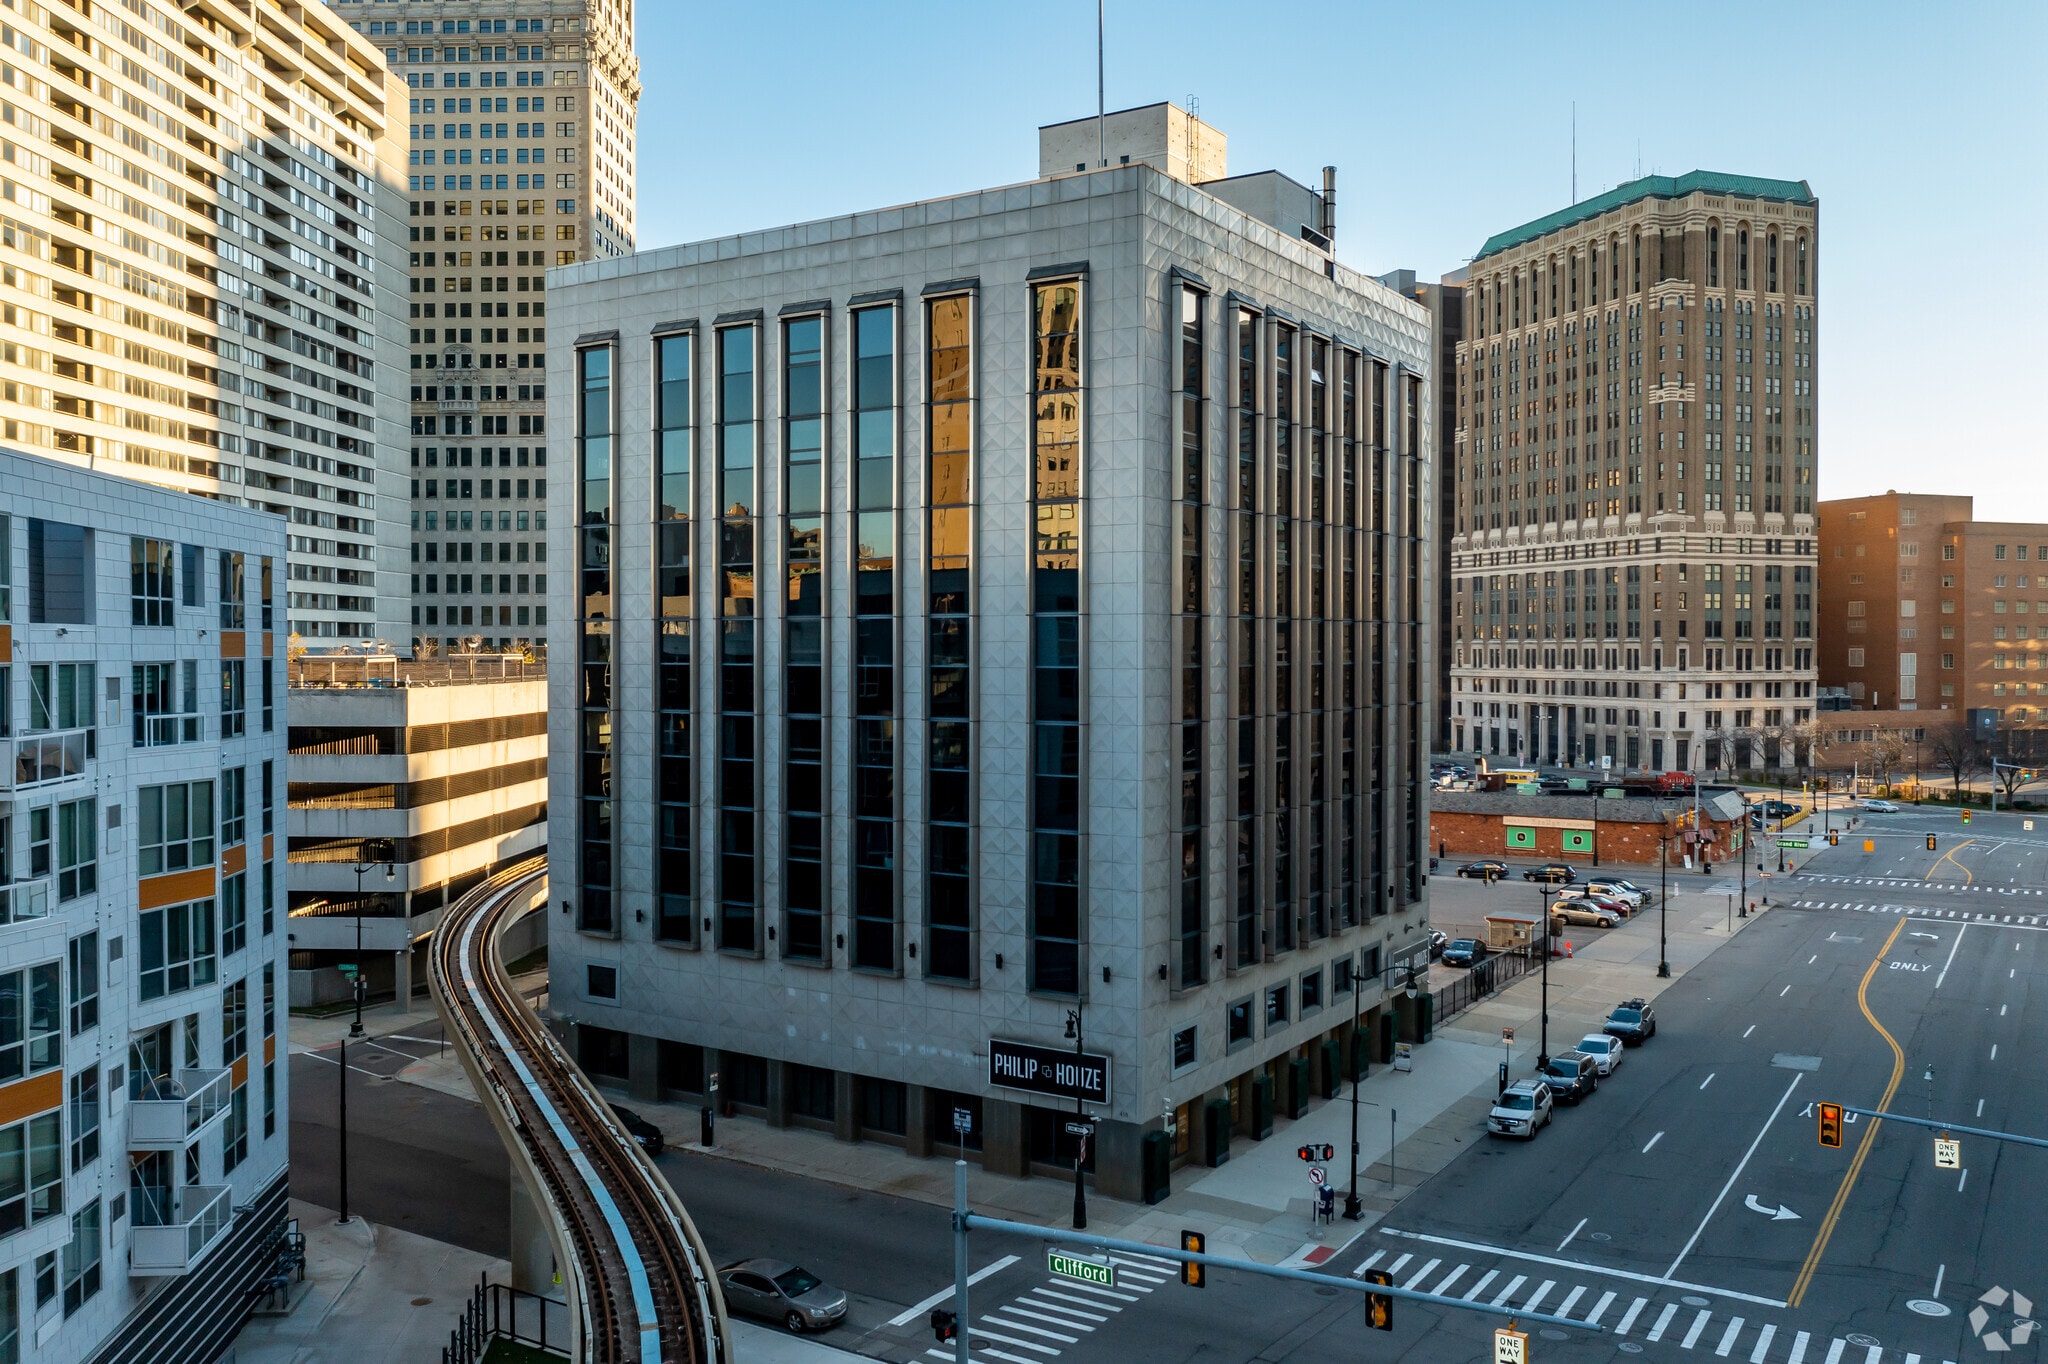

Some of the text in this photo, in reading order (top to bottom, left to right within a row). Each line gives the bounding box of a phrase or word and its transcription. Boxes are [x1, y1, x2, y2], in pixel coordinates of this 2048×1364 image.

[1889, 961, 1932, 972] ONLY
[995, 1053, 1038, 1080] PHILIP
[1056, 1062, 1102, 1091] HOUZE
[1938, 1143, 1955, 1151] ONE
[1938, 1150, 1956, 1158] WAY
[1054, 1257, 1108, 1283] Clifford
[1499, 1337, 1519, 1349] ONE
[1499, 1346, 1520, 1358] WAY
